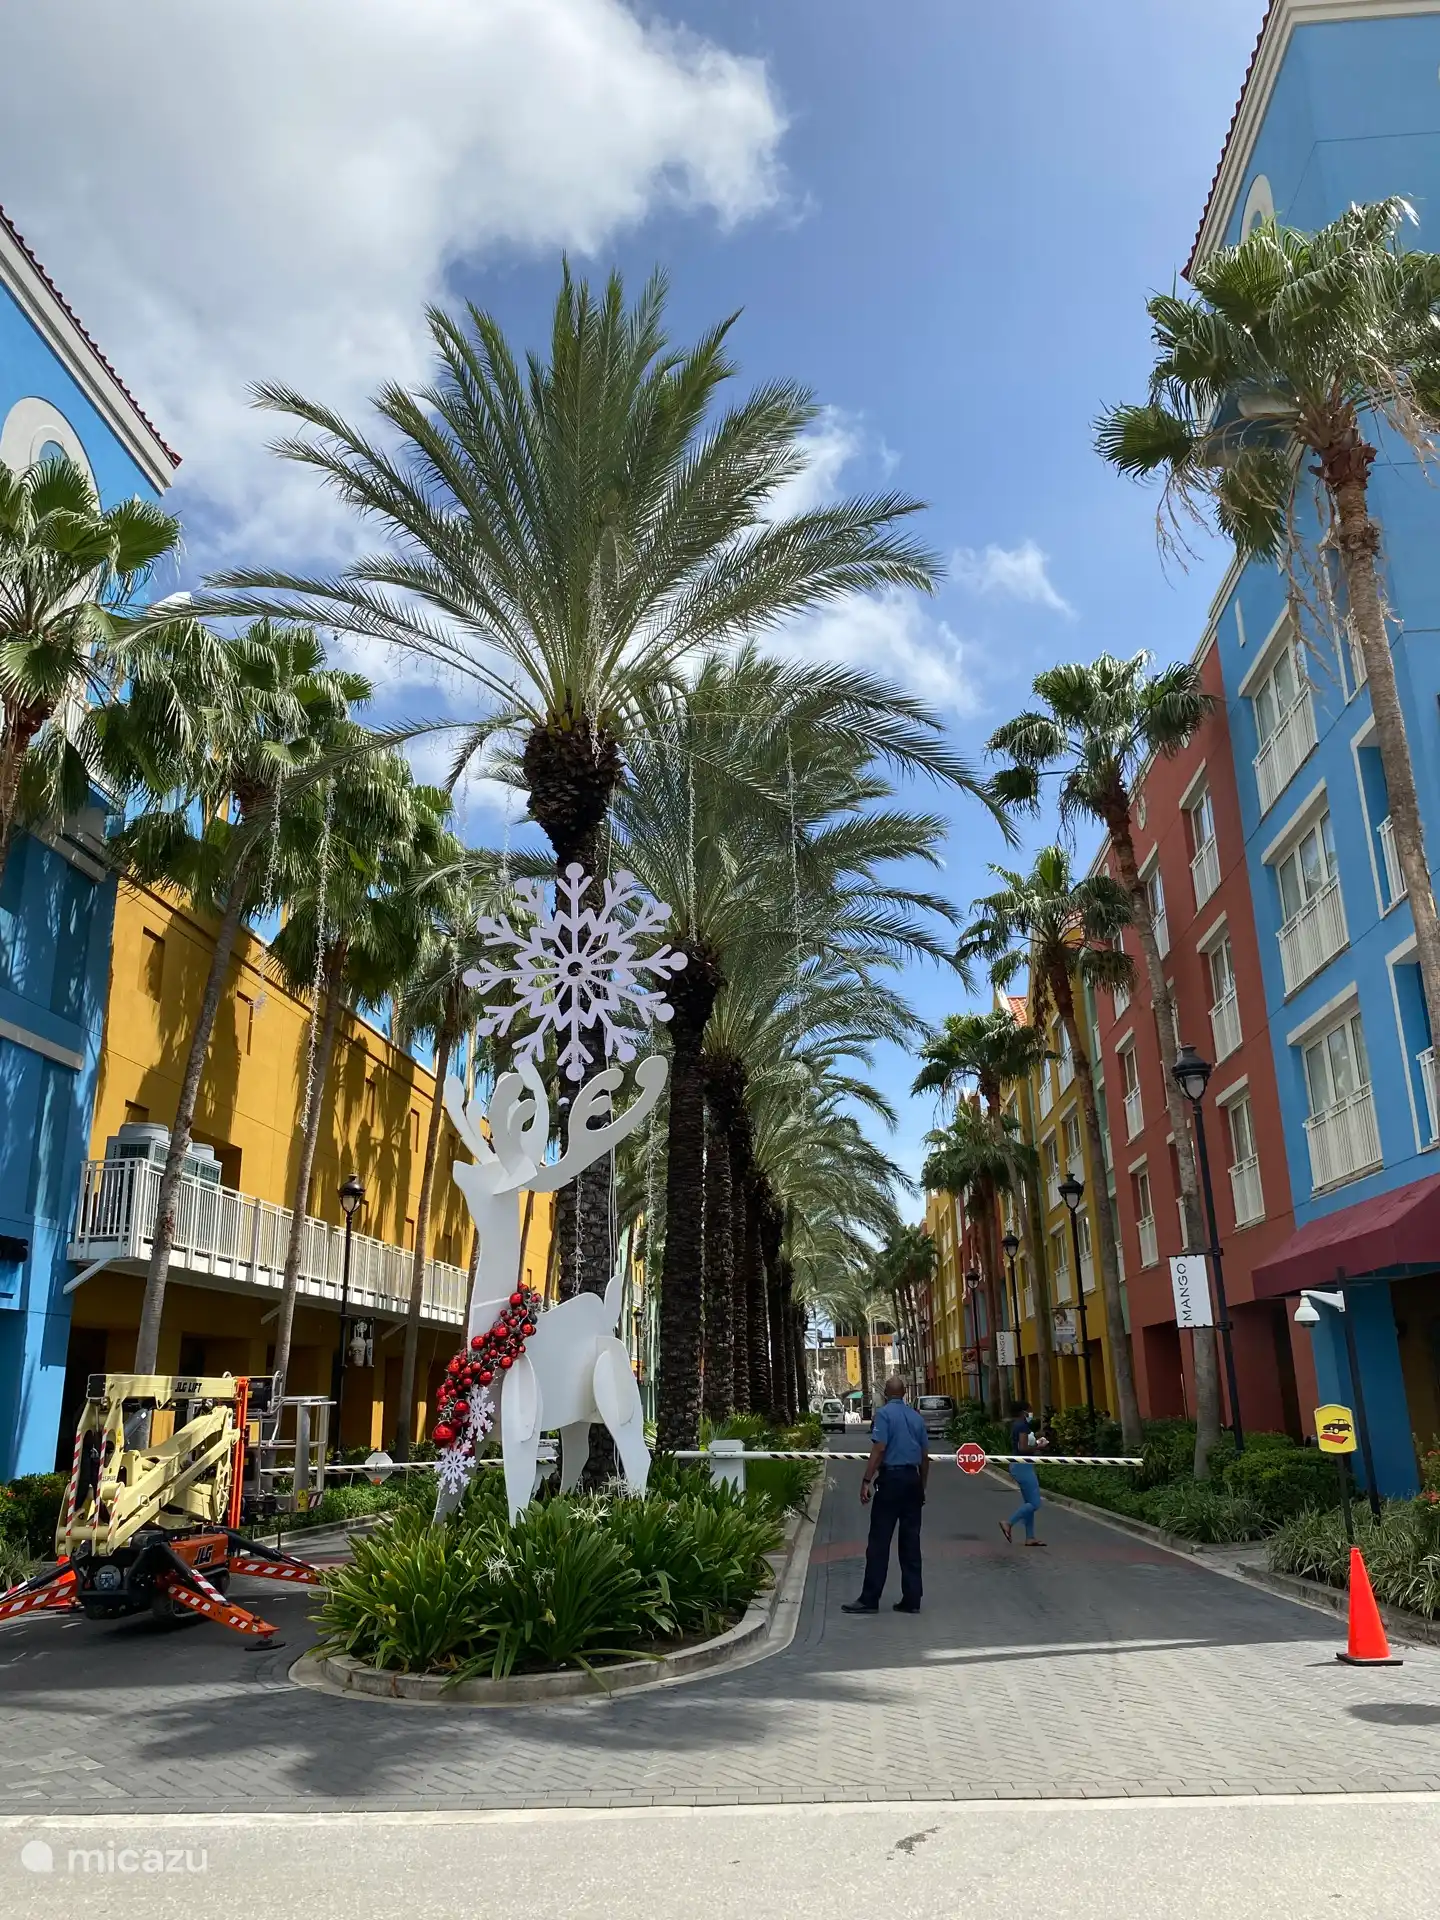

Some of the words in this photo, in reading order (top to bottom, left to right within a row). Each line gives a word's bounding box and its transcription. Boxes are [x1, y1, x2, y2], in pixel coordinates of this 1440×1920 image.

[1176, 1263, 1192, 1321] MANGO
[187, 1382, 203, 1393] LIFT
[958, 1454, 984, 1463] STOP
[193, 1544, 214, 1566] JLG
